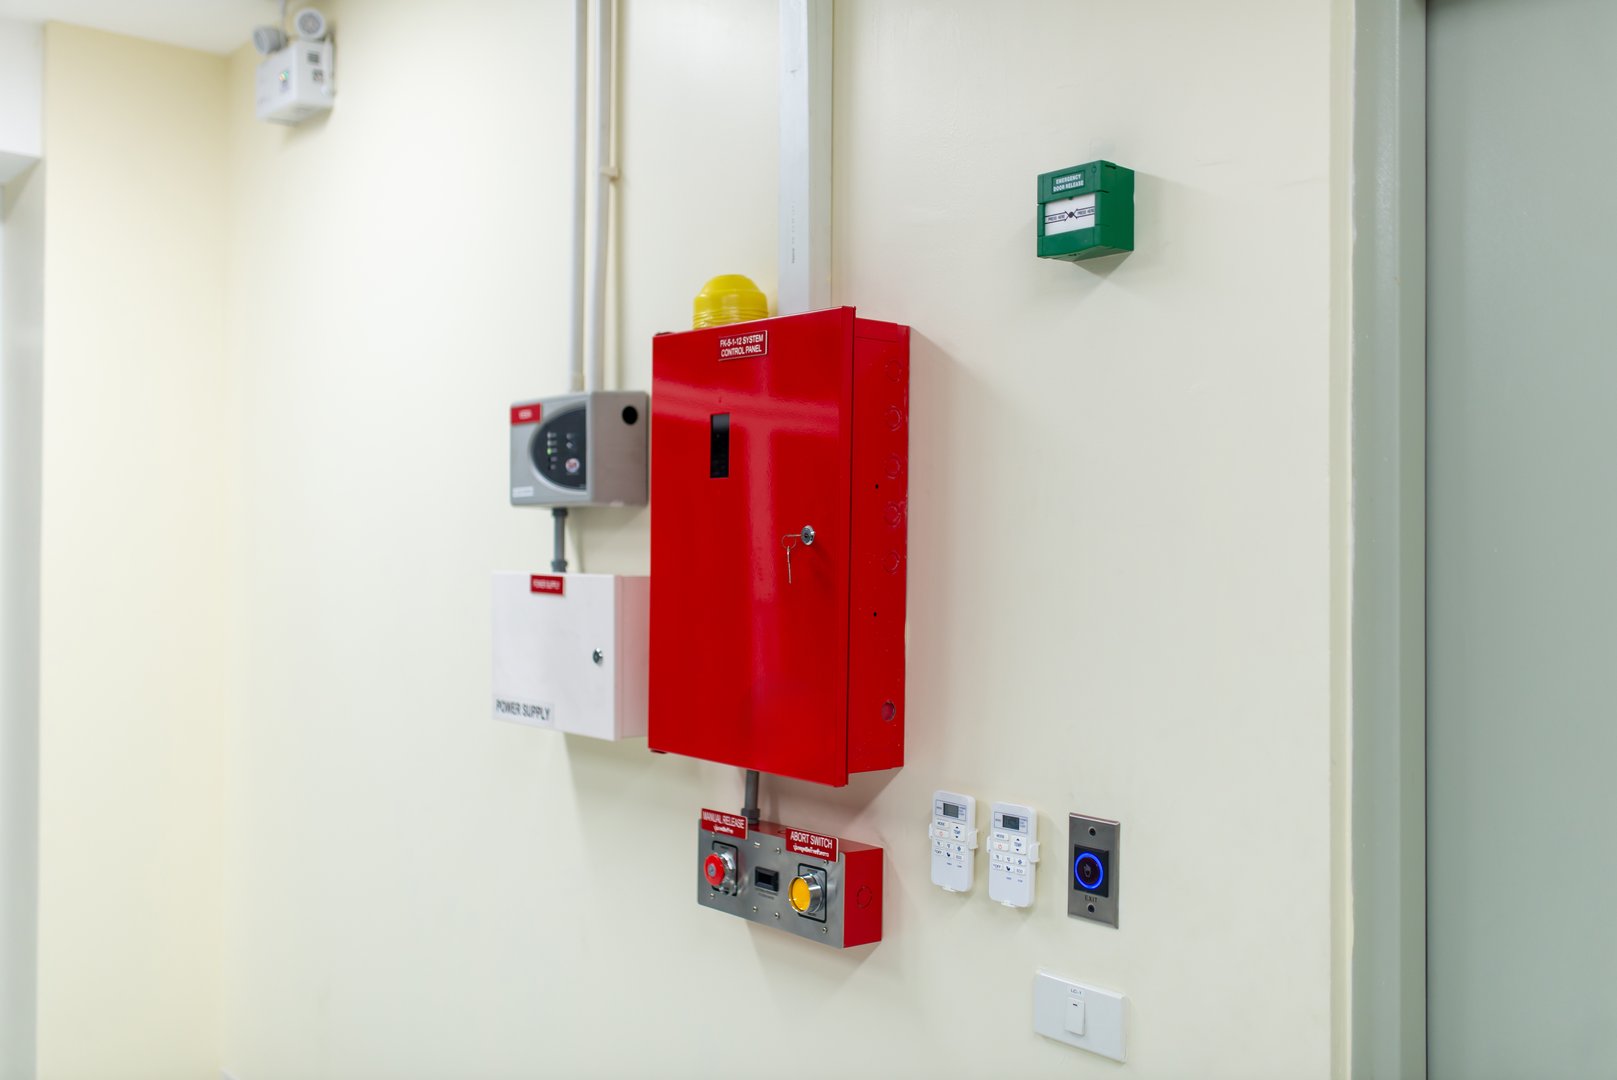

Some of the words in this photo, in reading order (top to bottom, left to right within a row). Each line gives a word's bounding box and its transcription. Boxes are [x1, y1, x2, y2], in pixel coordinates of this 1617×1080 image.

[1056, 174, 1081, 184] EMERGENCY
[1065, 180, 1084, 189] RELEASE
[720, 337, 742, 347] FK-5-1-12
[742, 334, 764, 344] SYSTEM
[721, 347, 745, 357] CONTROL
[745, 345, 762, 354] PANEL
[496, 698, 521, 716] POWER
[522, 702, 551, 721] SUPPLY
[702, 811, 723, 824] MANUAL
[722, 814, 745, 829] RELEASE
[790, 830, 810, 844] ABORT
[810, 834, 833, 849] SWITCH
